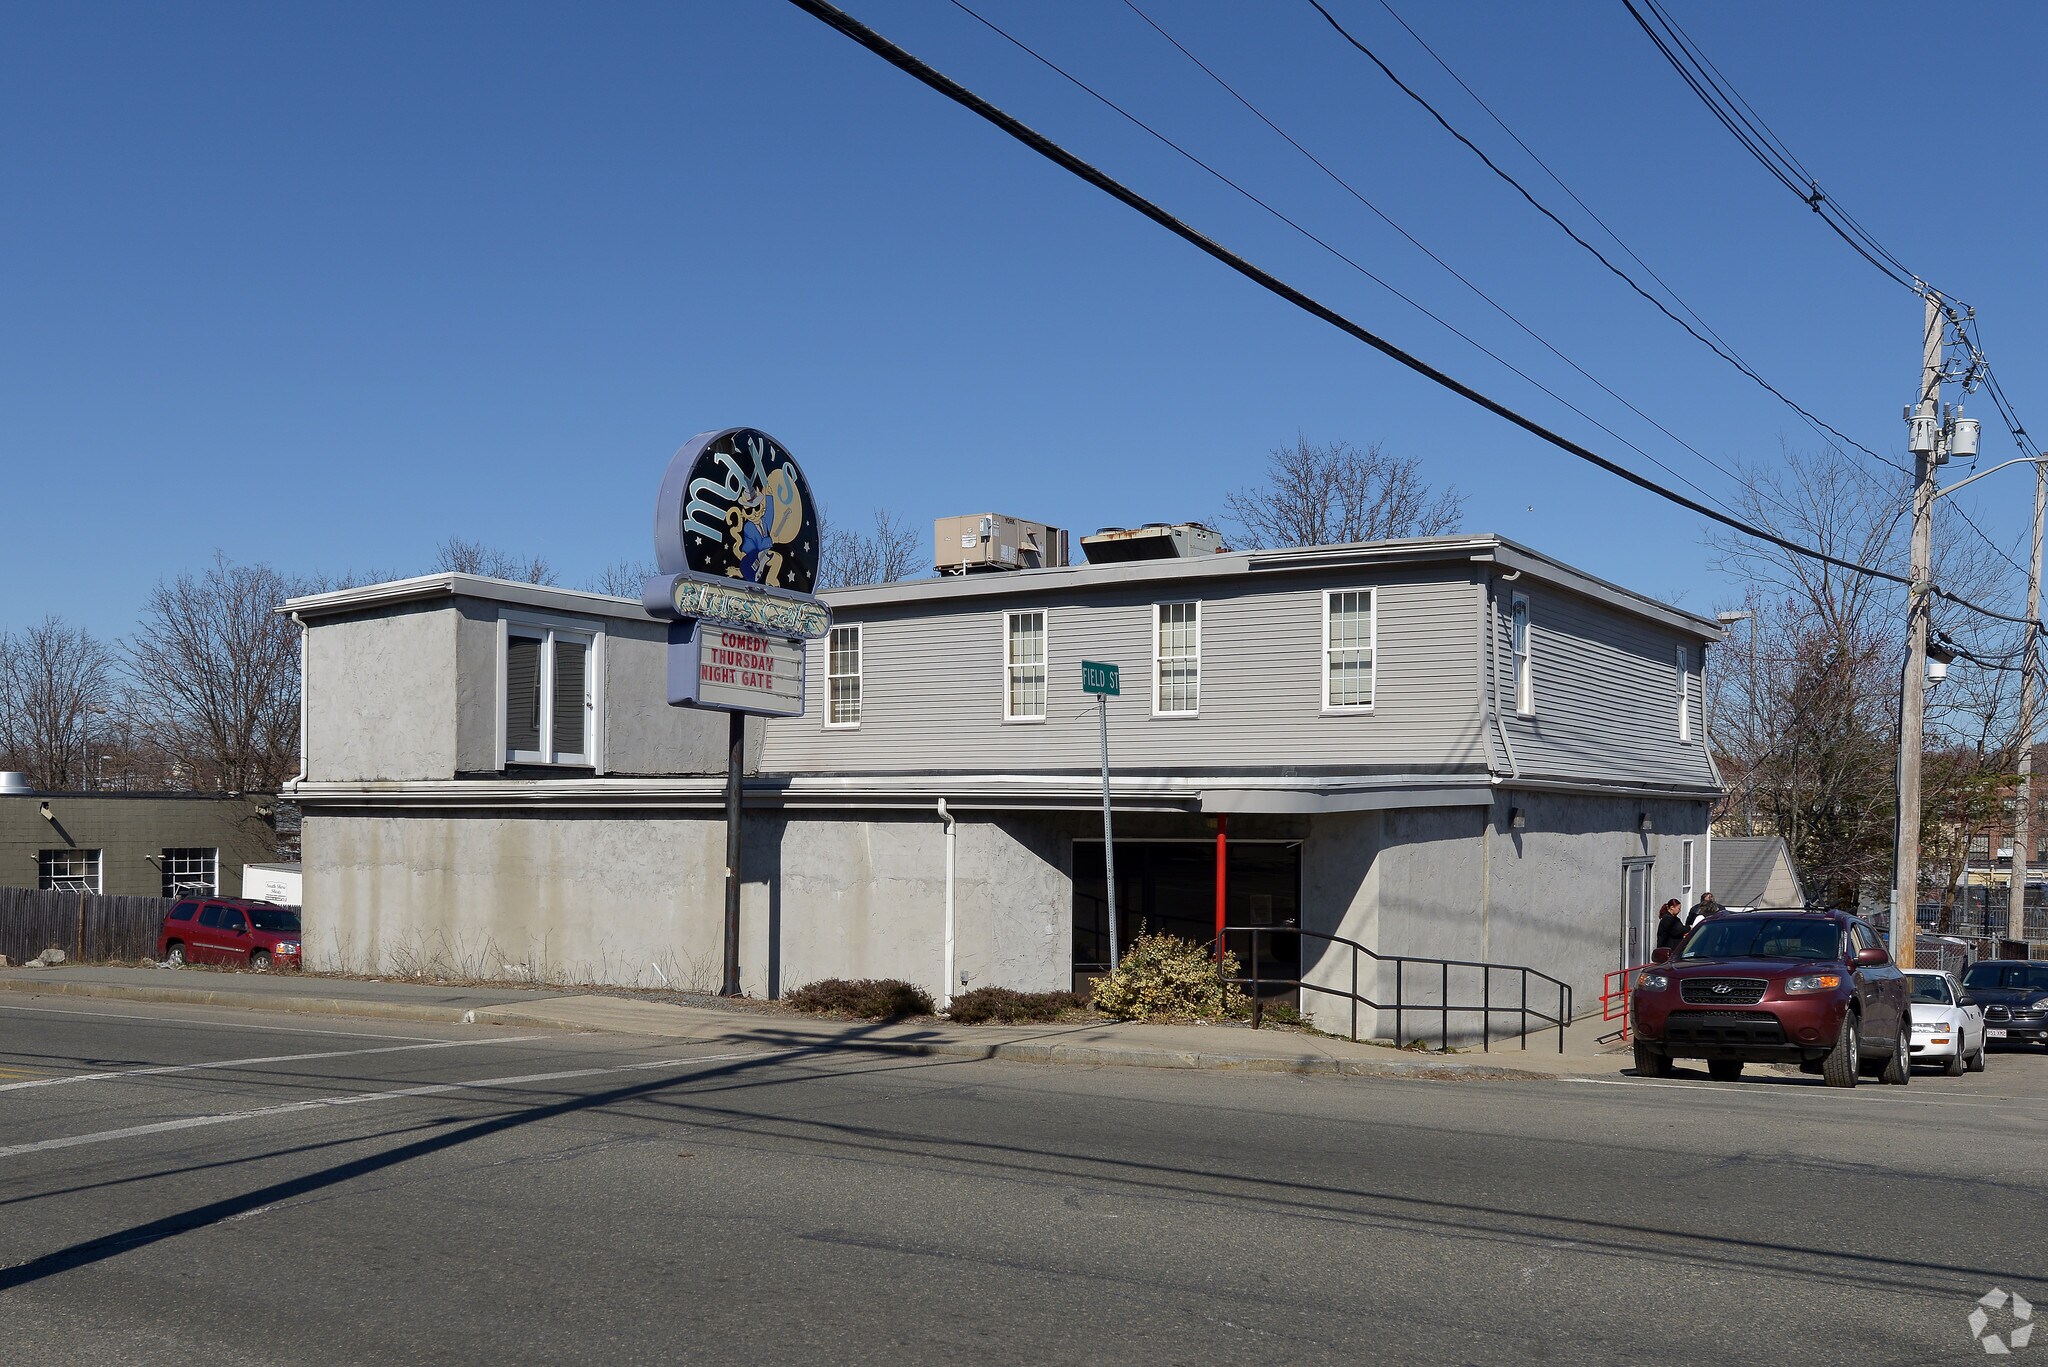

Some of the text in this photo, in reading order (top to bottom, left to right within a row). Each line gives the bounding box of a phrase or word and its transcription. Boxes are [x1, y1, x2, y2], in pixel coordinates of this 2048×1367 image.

[721, 632, 769, 653] COMEDY
[711, 648, 774, 672] THURSDAY
[701, 664, 773, 689] NIGHT GATE
[1083, 667, 1118, 689] FIELD ST
